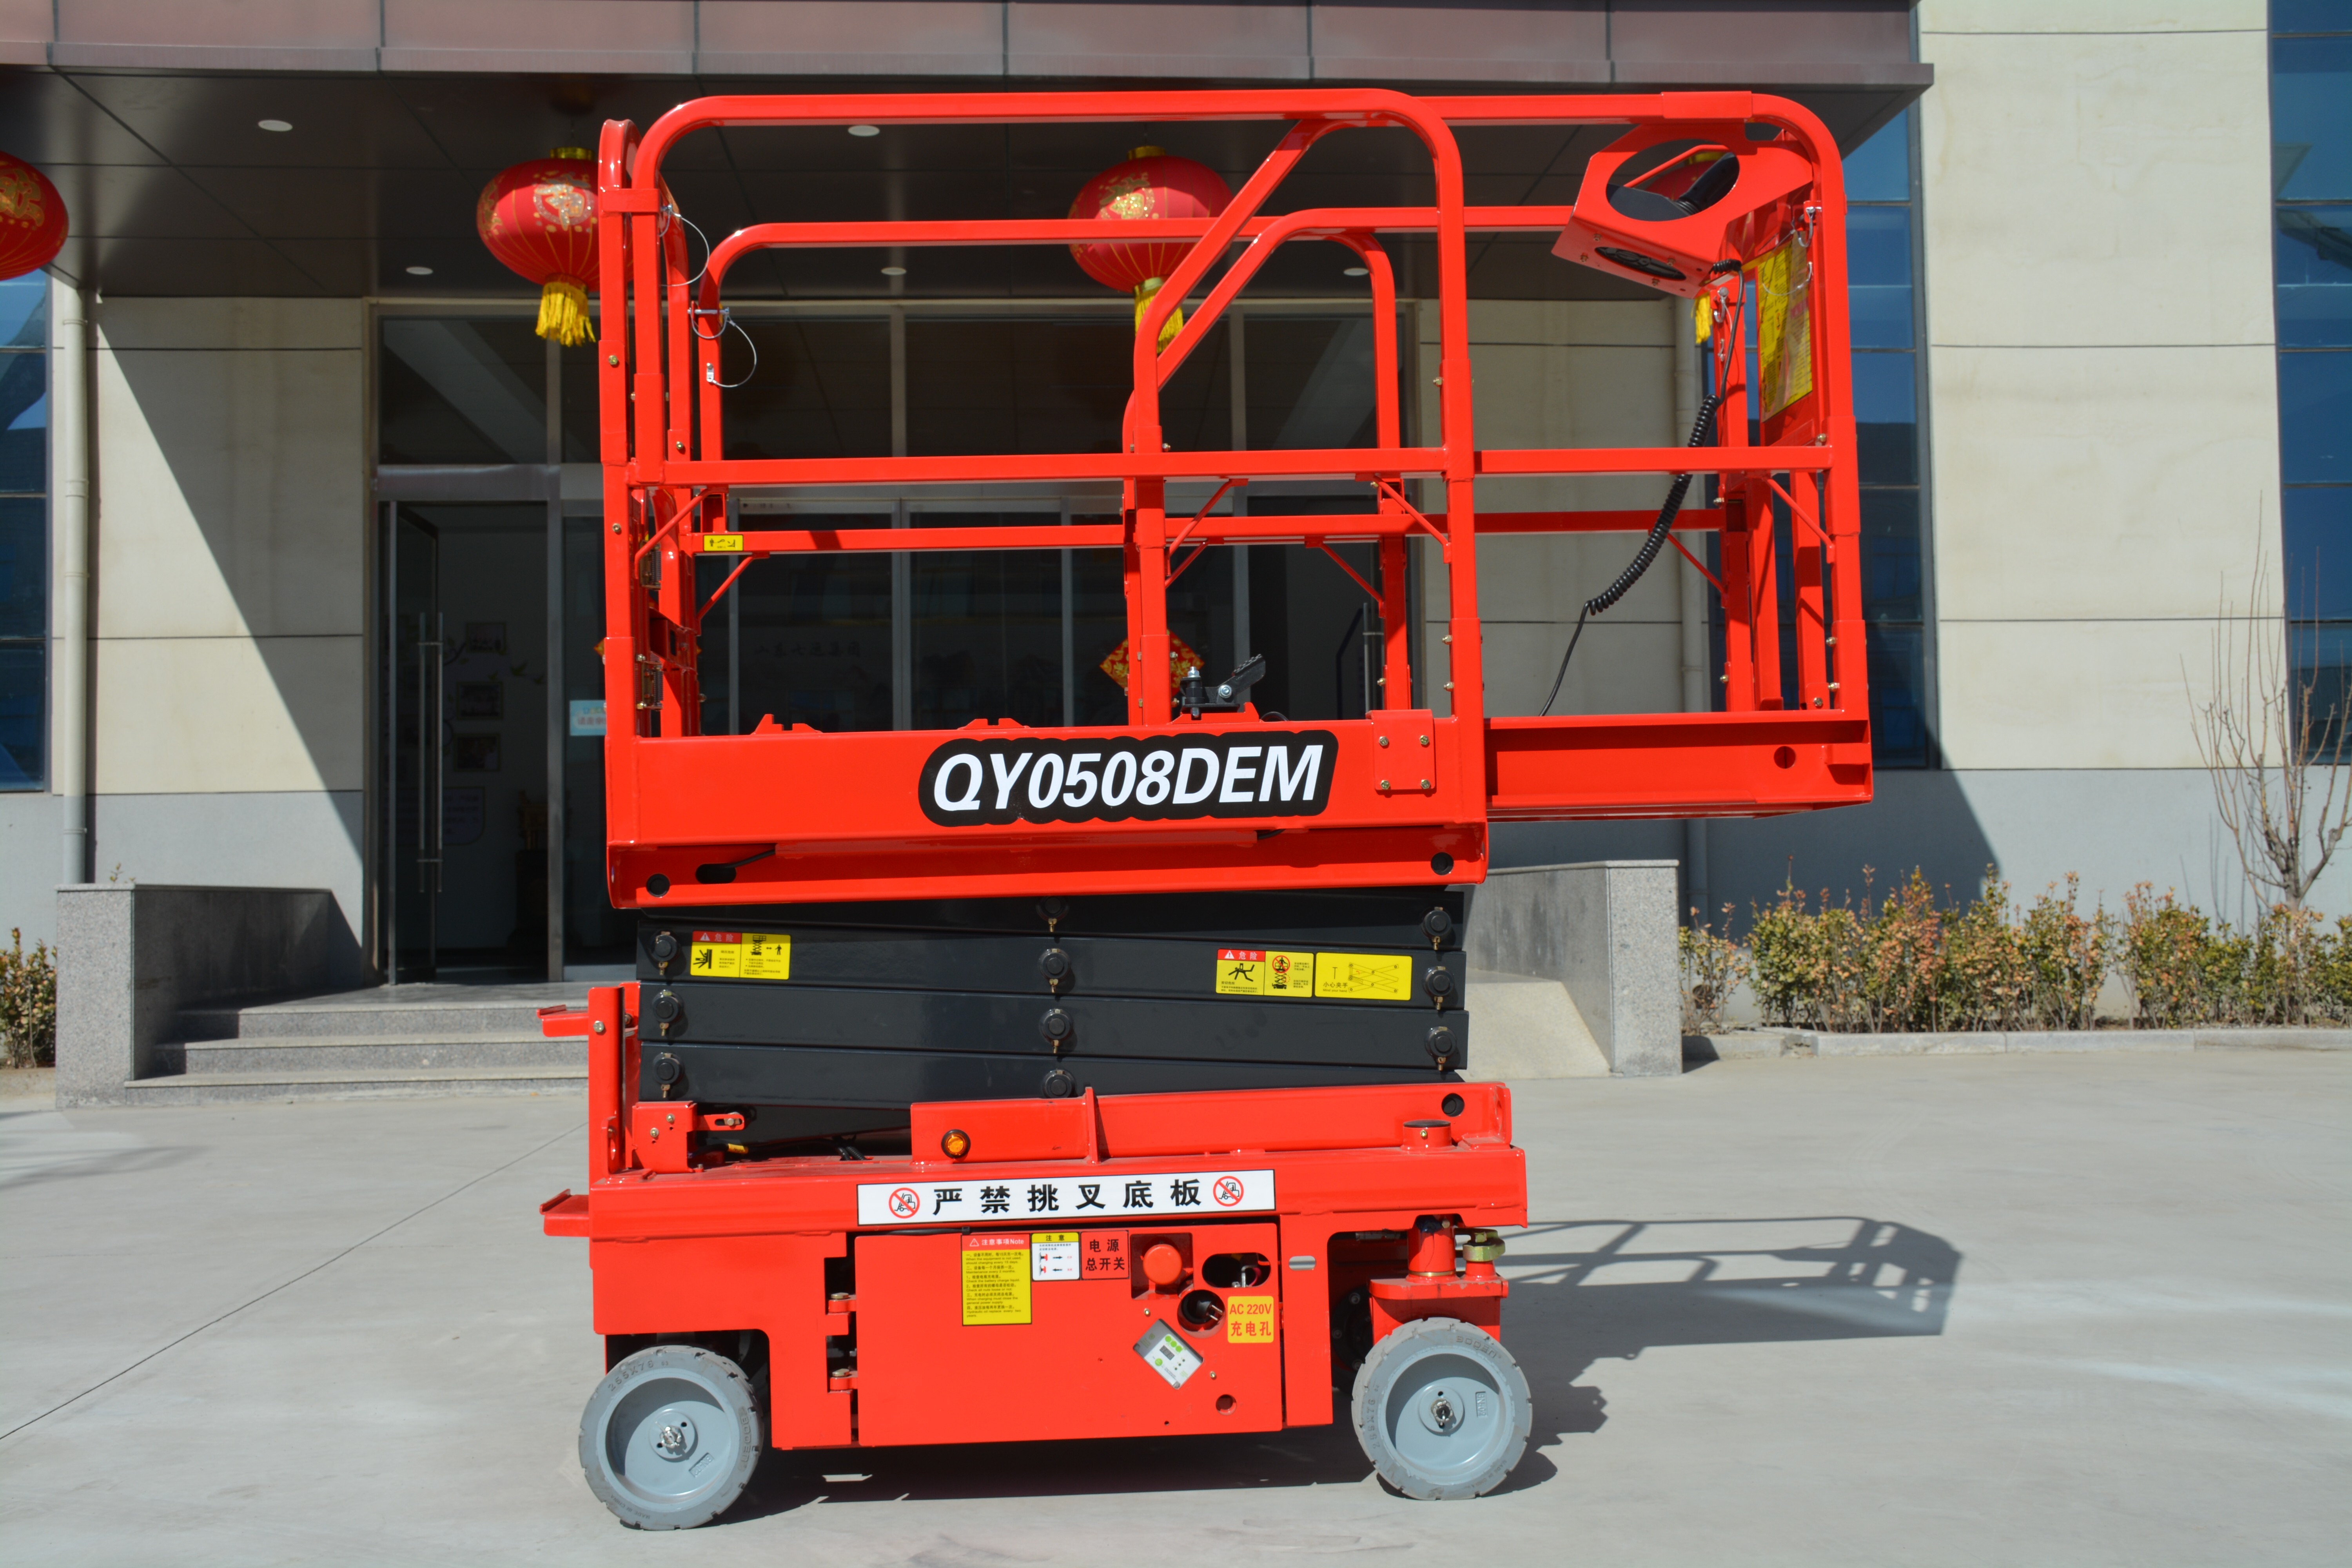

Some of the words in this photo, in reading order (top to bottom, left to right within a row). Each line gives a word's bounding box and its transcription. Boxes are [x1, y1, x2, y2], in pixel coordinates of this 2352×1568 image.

[934, 744, 1323, 811] QY0508DEM
[715, 933, 734, 942] 危险
[1239, 951, 1257, 960] 危险
[933, 1178, 1201, 1216] 严禁挑叉底板
[1090, 1239, 1119, 1252] 电源
[1085, 1257, 1125, 1271] 总开关
[1229, 1304, 1244, 1314] AC
[1247, 1304, 1272, 1314] 220V
[1231, 1321, 1271, 1336] 充电孔
[608, 1359, 653, 1392] 255X76
[1367, 1399, 1380, 1449] 255X76
